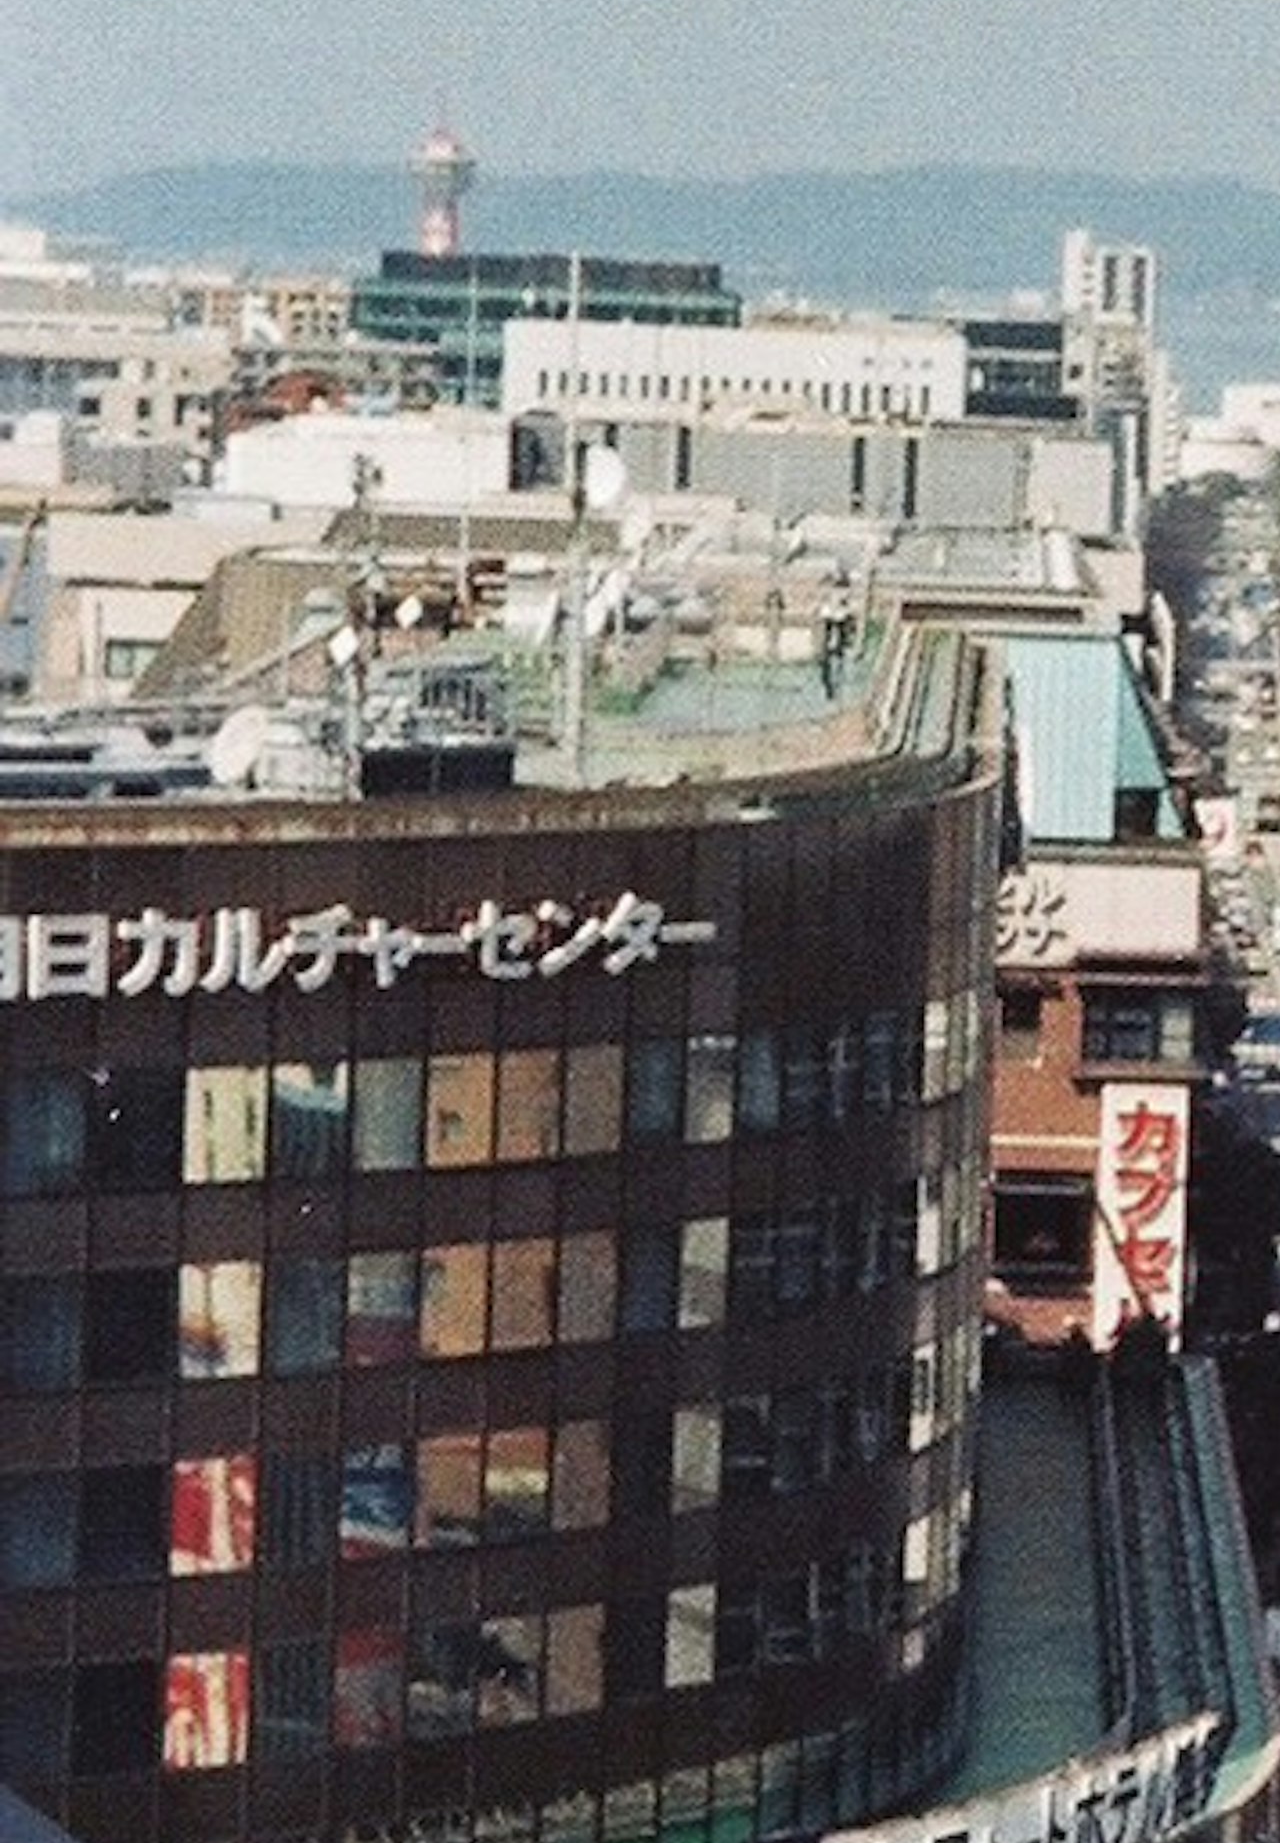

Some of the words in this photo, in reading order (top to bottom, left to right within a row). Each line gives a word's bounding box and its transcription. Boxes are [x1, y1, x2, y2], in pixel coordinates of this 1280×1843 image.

[0, 890, 717, 1000] 日カルチャーセンター
